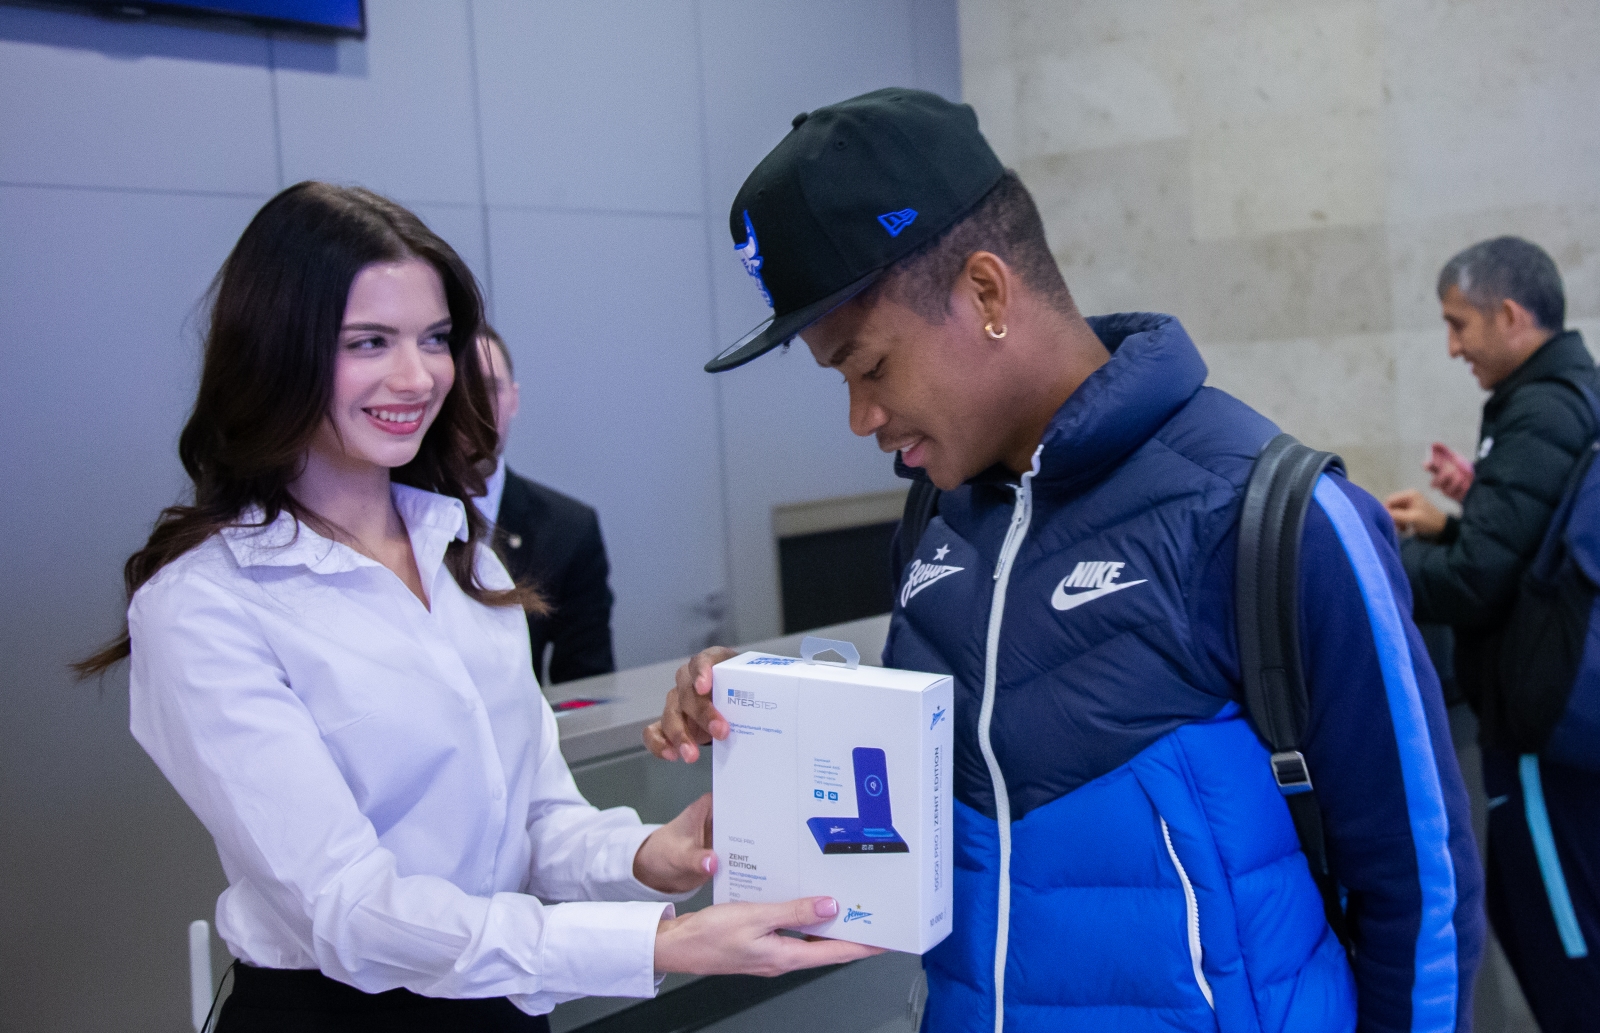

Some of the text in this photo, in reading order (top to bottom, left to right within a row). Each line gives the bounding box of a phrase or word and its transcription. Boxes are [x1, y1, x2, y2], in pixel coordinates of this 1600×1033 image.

[1065, 561, 1126, 588] NIKE
[728, 697, 778, 710] INTERSTEP
[729, 853, 749, 862] ZENIT
[729, 860, 757, 870] EDITION
